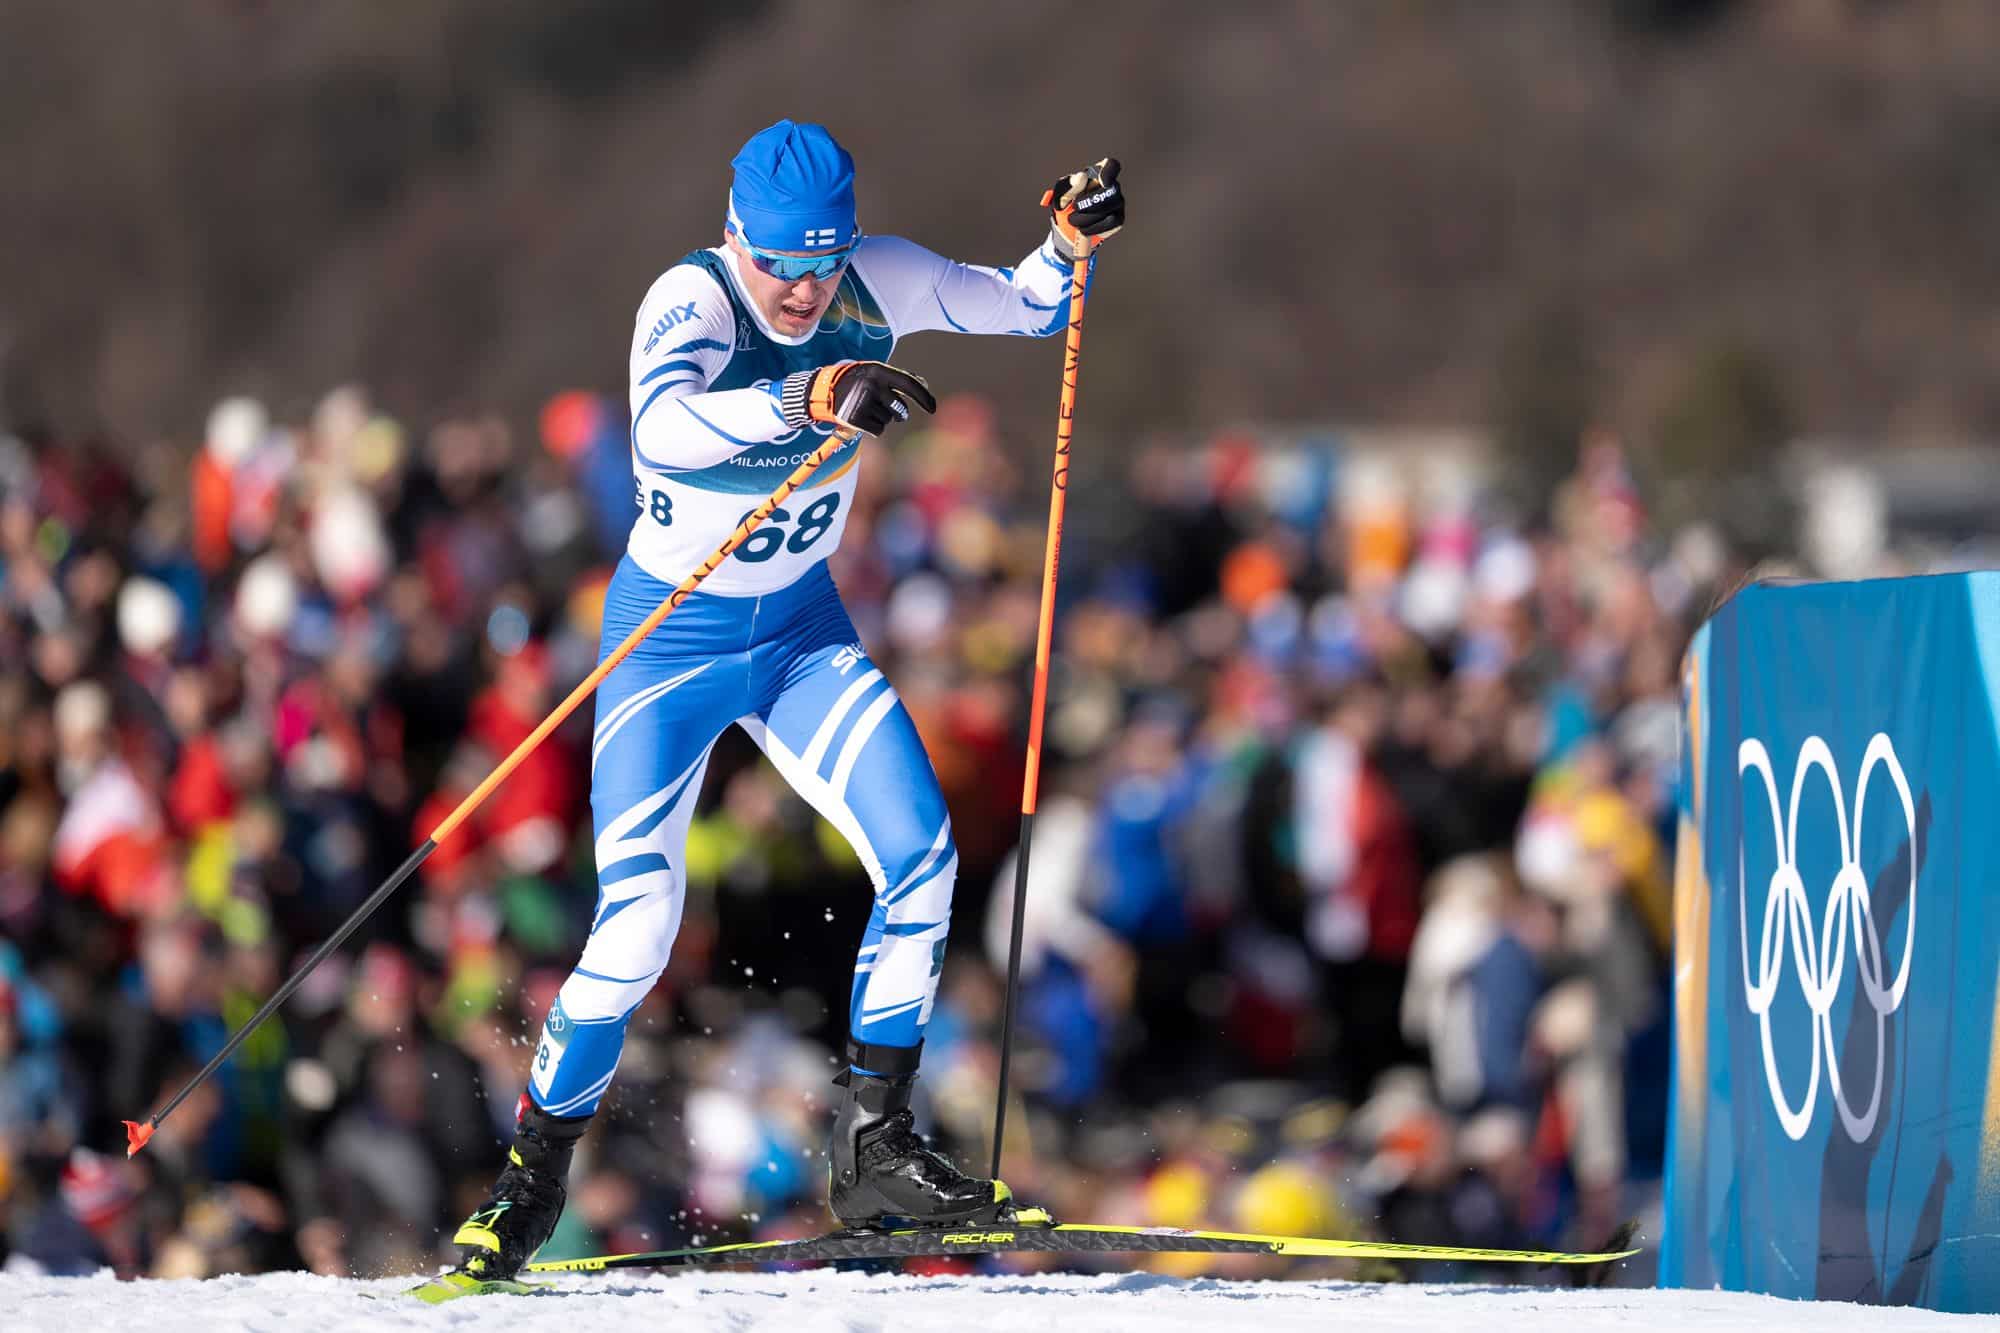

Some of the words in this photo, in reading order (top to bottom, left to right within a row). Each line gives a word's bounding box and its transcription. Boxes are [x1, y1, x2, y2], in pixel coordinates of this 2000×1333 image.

[643, 301, 702, 355] SWIX
[729, 455, 788, 468] MILANO
[733, 492, 840, 563] 68
[942, 1232, 1015, 1245] FISCHER
